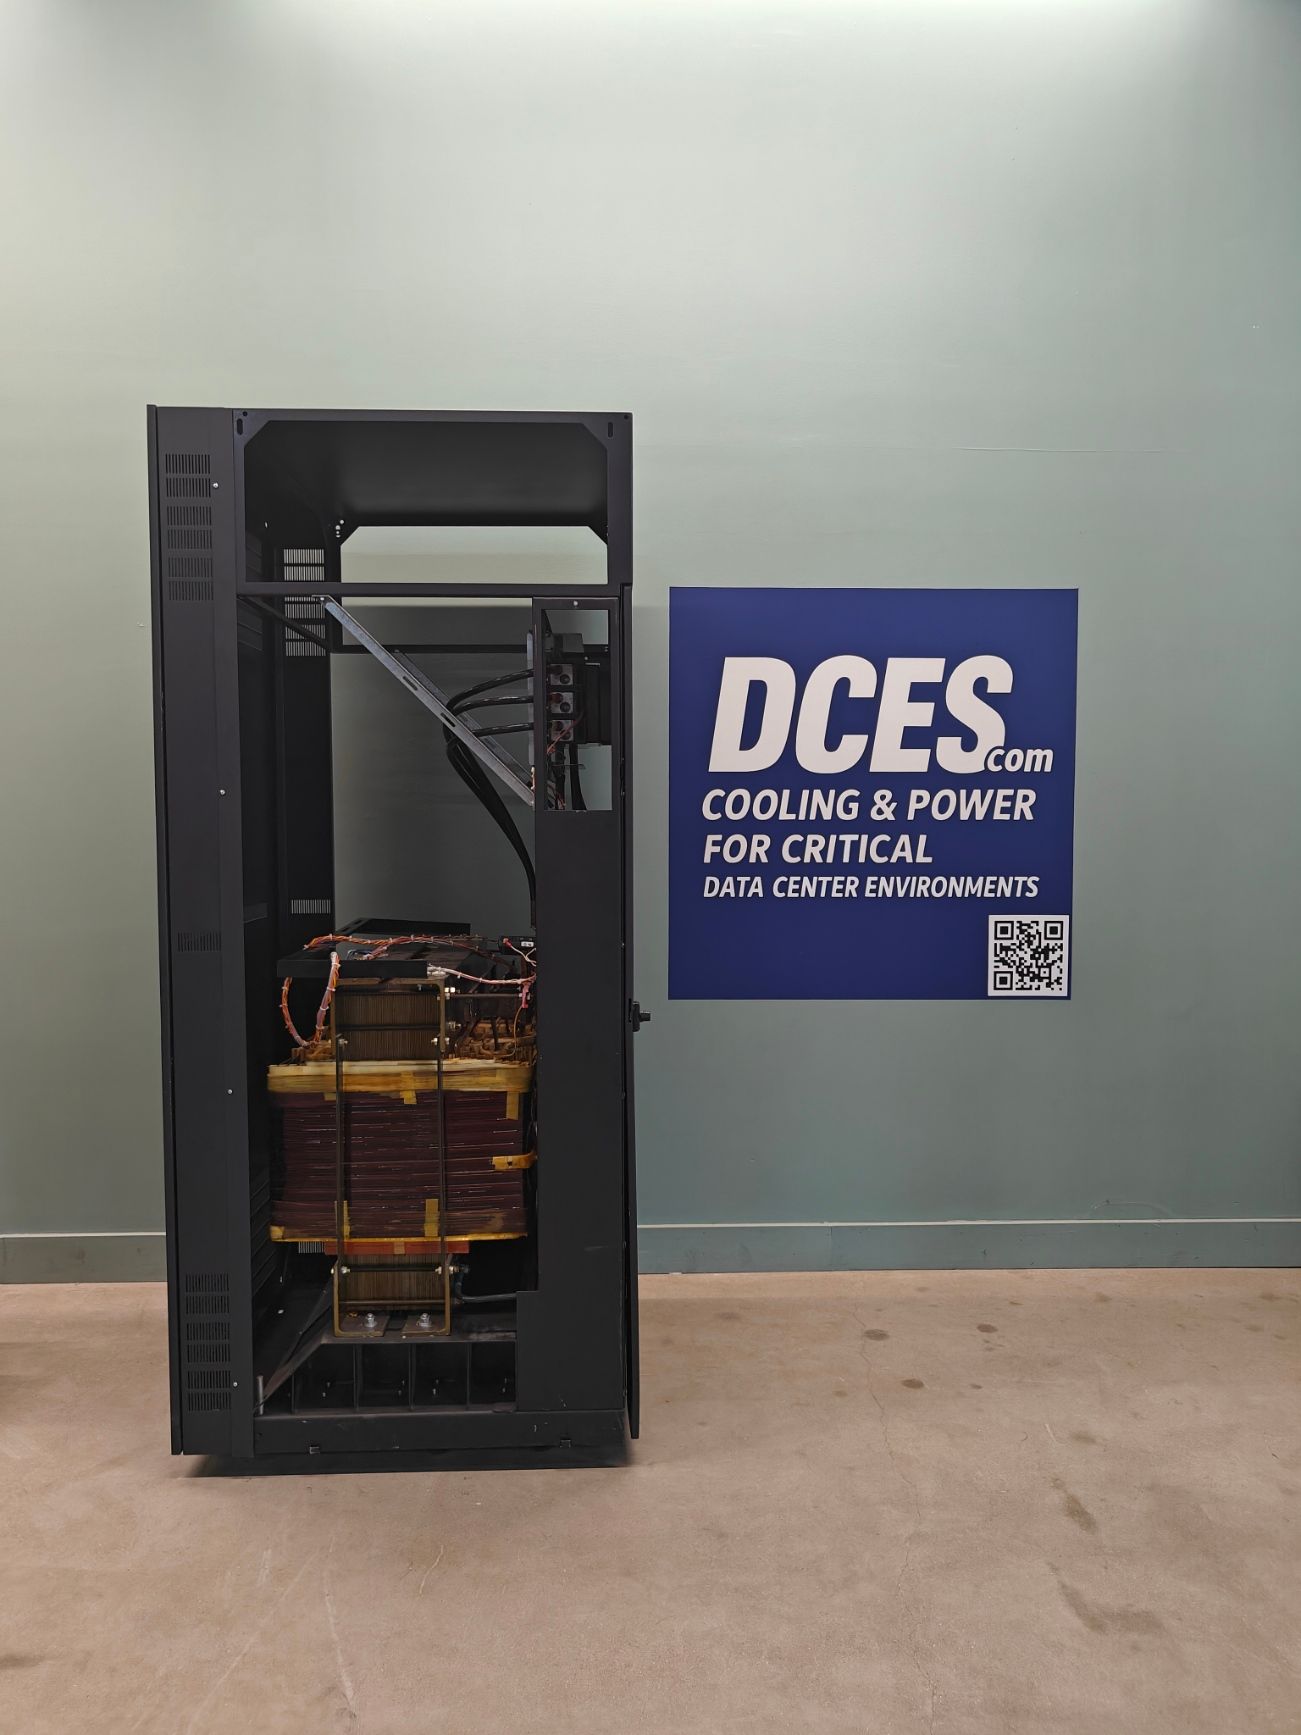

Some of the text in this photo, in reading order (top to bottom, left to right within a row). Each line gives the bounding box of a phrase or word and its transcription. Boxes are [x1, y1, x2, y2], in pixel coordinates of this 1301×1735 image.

[708, 654, 1014, 774] DCES
[702, 788, 1037, 821] COOLING & POWER
[703, 833, 934, 864] FOR CRITICAL
[703, 876, 1040, 898] DATA CENTER ENVIRONMENTS
